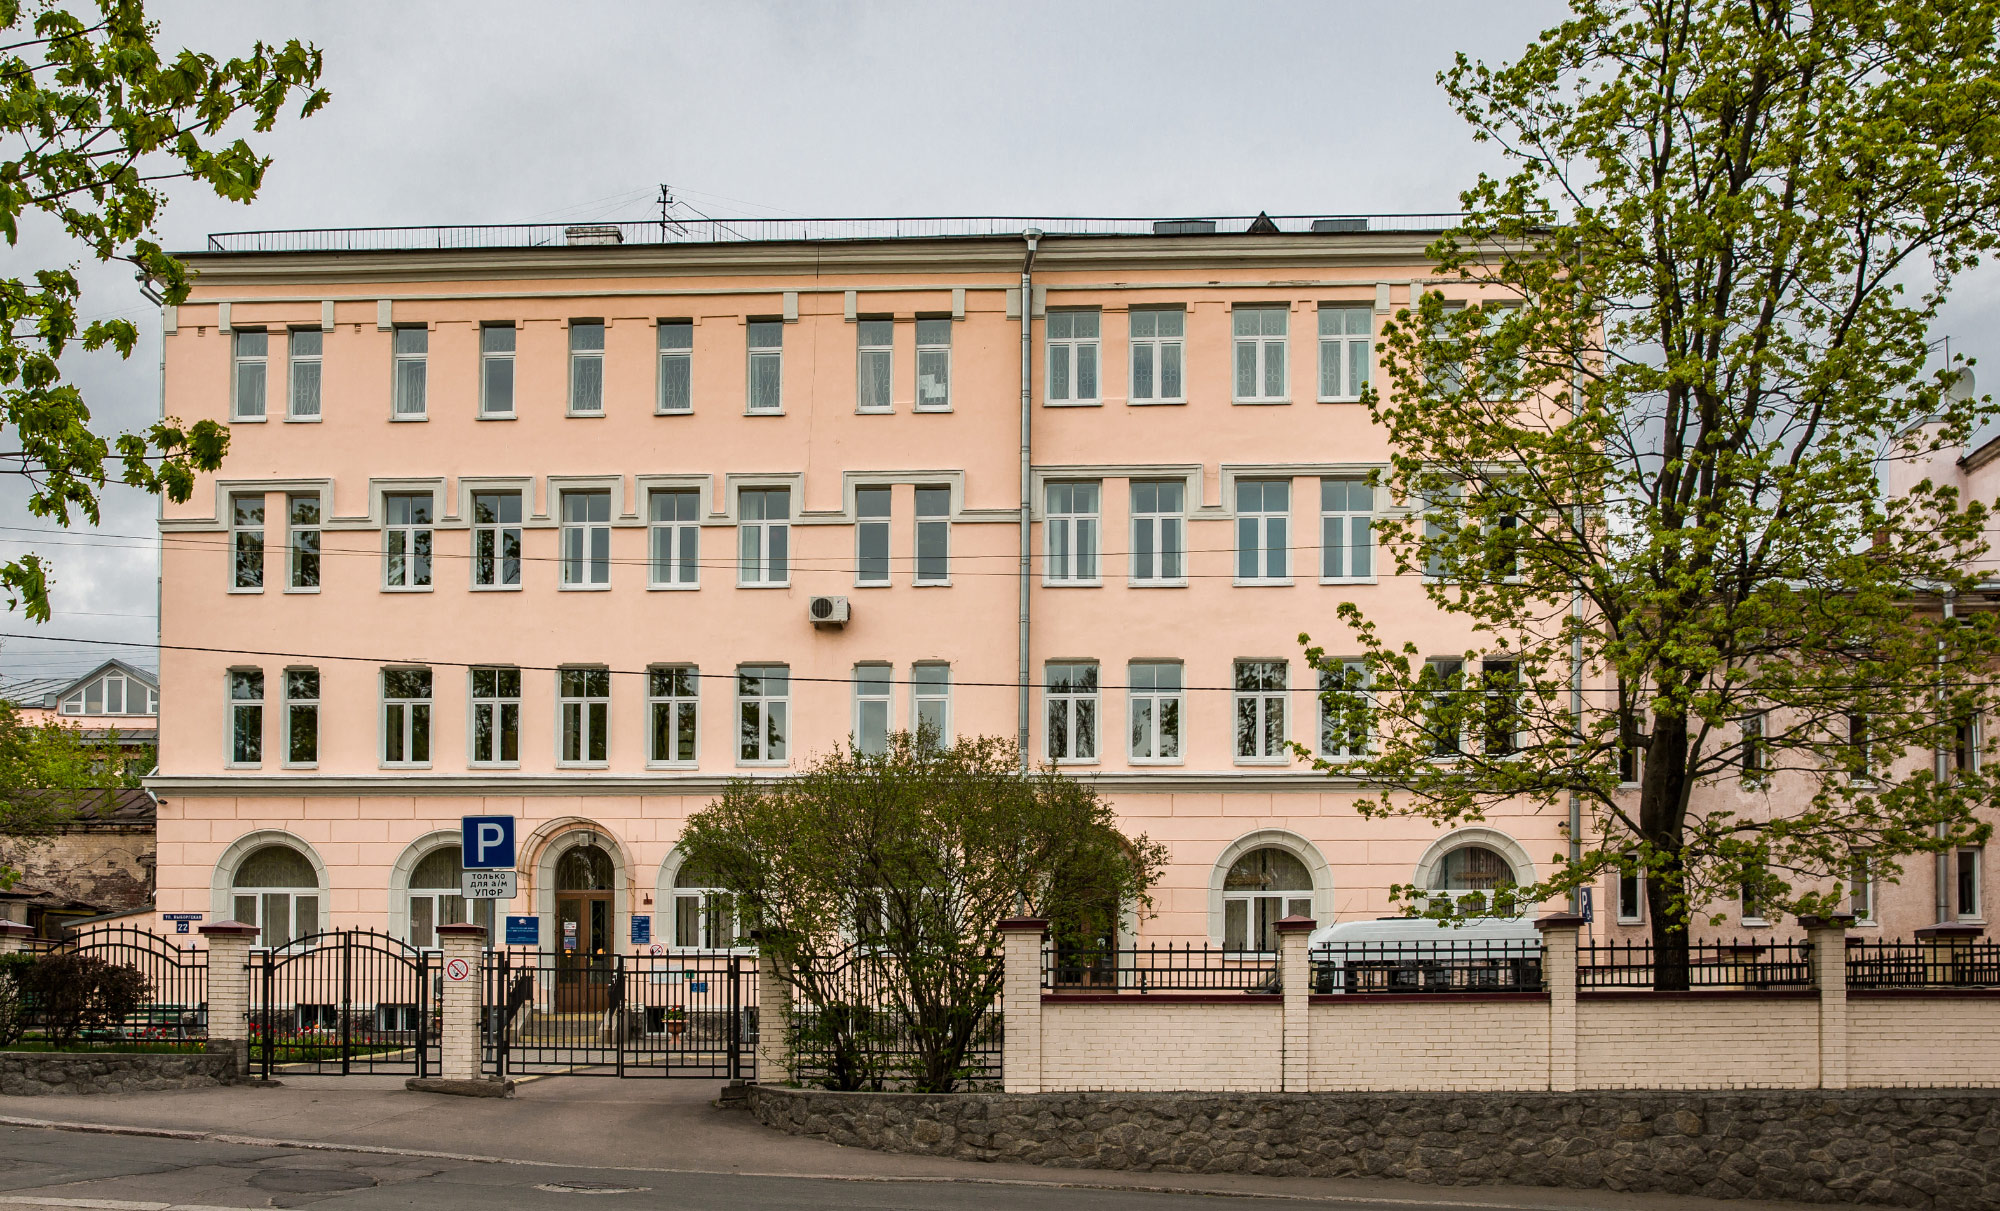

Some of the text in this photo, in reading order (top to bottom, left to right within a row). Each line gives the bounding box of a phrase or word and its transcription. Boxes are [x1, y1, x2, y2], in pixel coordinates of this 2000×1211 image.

[477, 822, 505, 863] P
[475, 888, 504, 897] УПФР
[177, 923, 188, 932] 22
